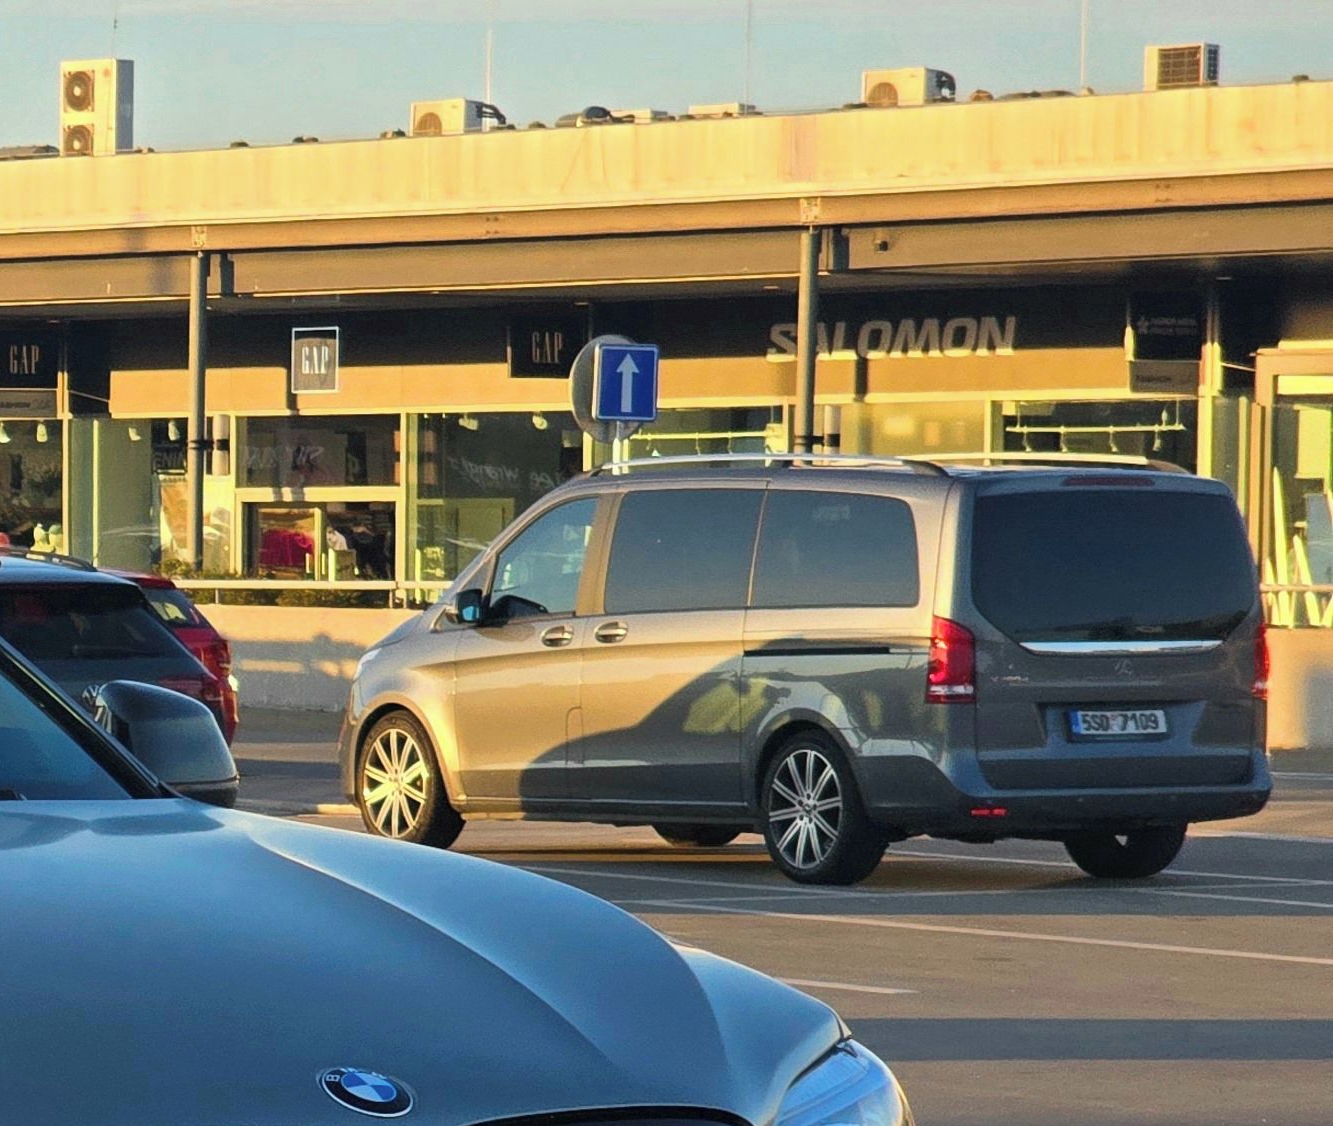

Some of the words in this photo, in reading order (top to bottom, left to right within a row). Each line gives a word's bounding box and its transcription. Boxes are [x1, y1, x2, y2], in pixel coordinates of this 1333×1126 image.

[9, 345, 39, 374] GAP
[302, 345, 329, 375] GAP
[532, 331, 562, 364] GAP
